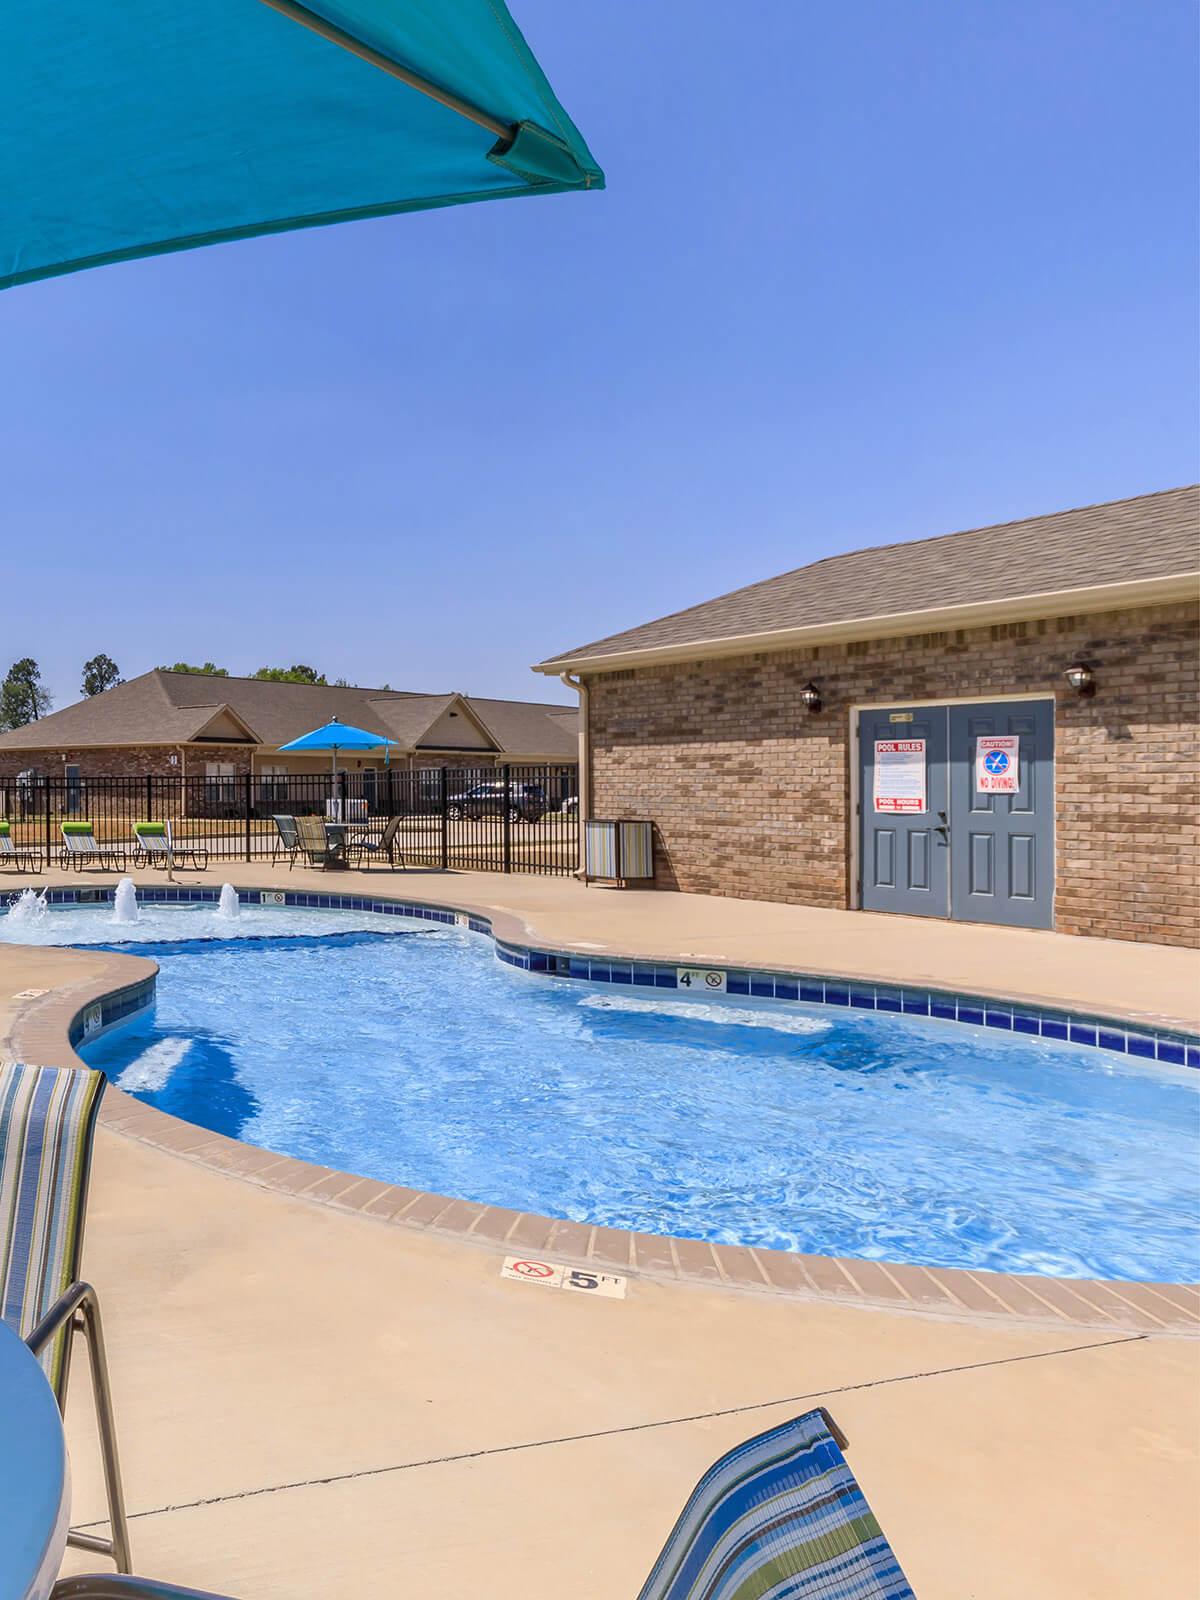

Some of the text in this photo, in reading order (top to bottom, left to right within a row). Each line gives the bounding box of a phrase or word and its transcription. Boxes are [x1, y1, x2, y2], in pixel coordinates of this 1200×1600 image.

[878, 743, 921, 751] POOL RULES
[980, 777, 1015, 789] NO DIVING!
[879, 798, 895, 806] POOL
[680, 971, 692, 987] 4
[568, 1271, 598, 1288] 5
[601, 1276, 621, 1284] FT
